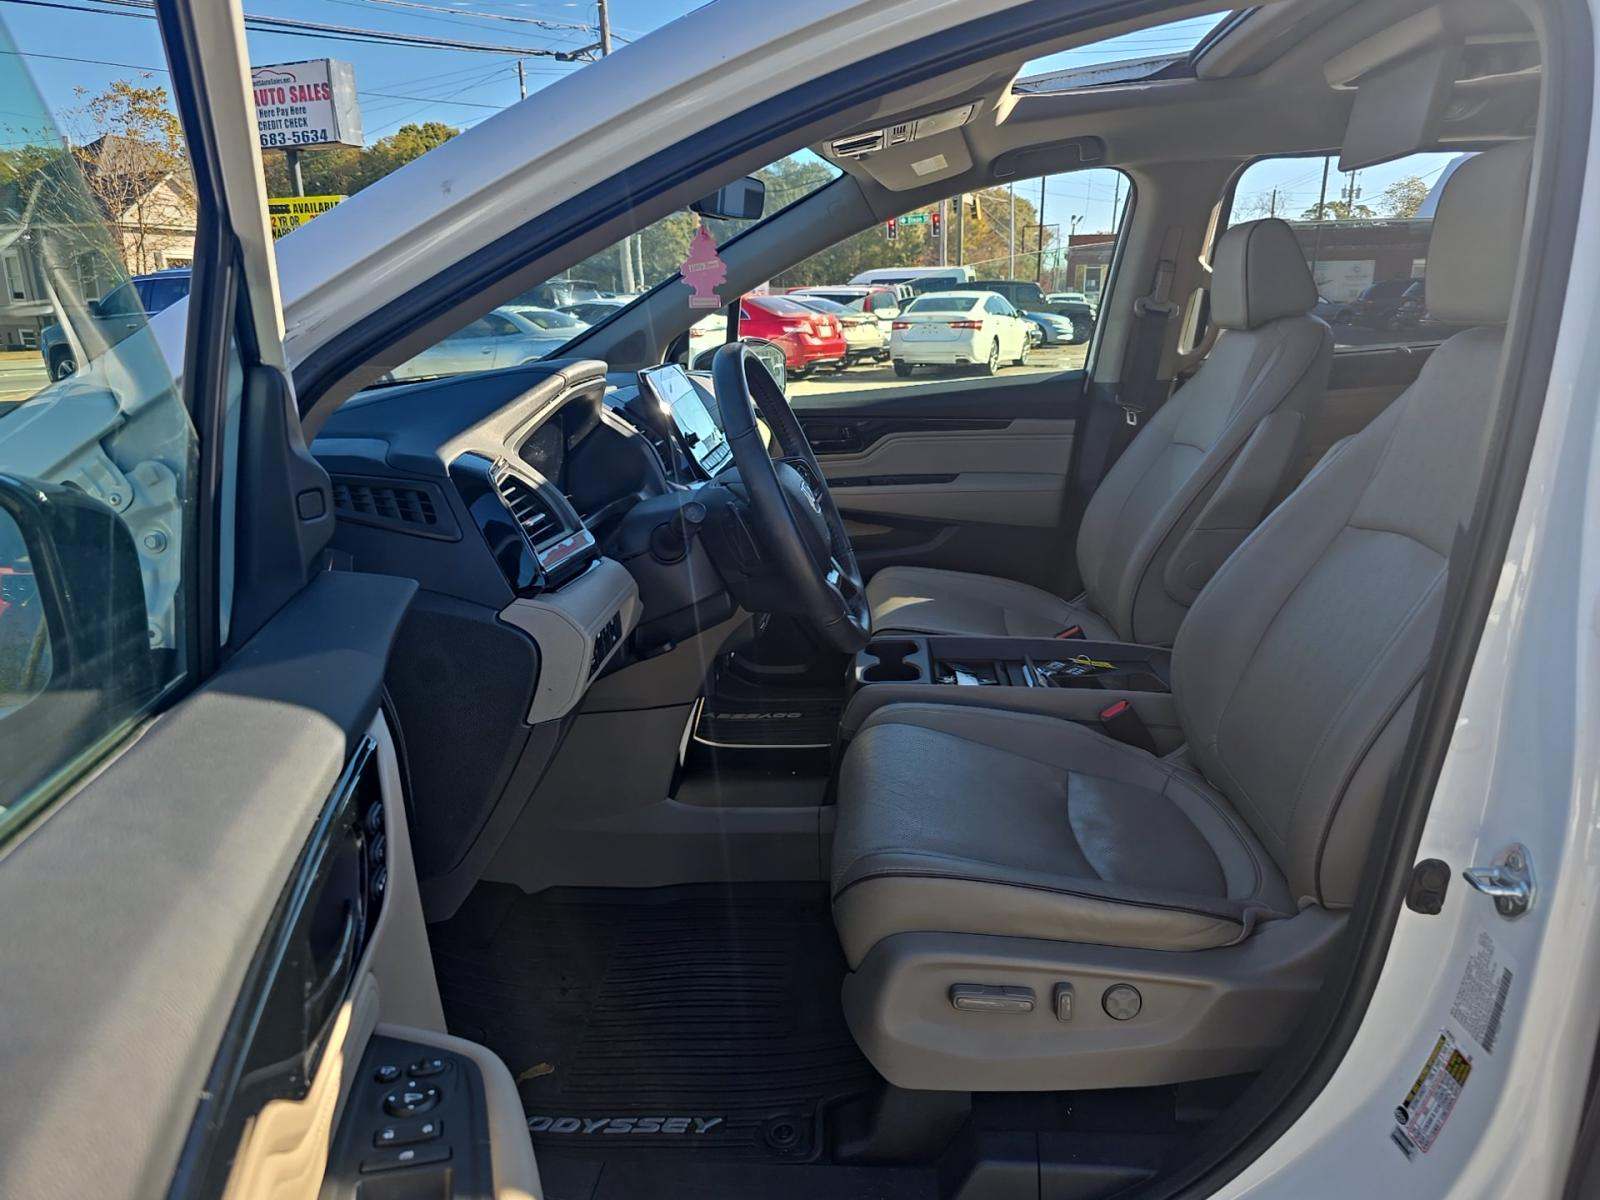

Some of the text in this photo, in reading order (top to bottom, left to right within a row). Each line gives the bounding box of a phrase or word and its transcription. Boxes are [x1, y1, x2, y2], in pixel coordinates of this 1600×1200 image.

[254, 82, 331, 107] AUTO SALES
[259, 105, 307, 118] Here Pay Here
[259, 117, 308, 131] CREDIT CHECK
[260, 128, 329, 146] 683-5634
[526, 1116, 723, 1134] ODYSSEY
